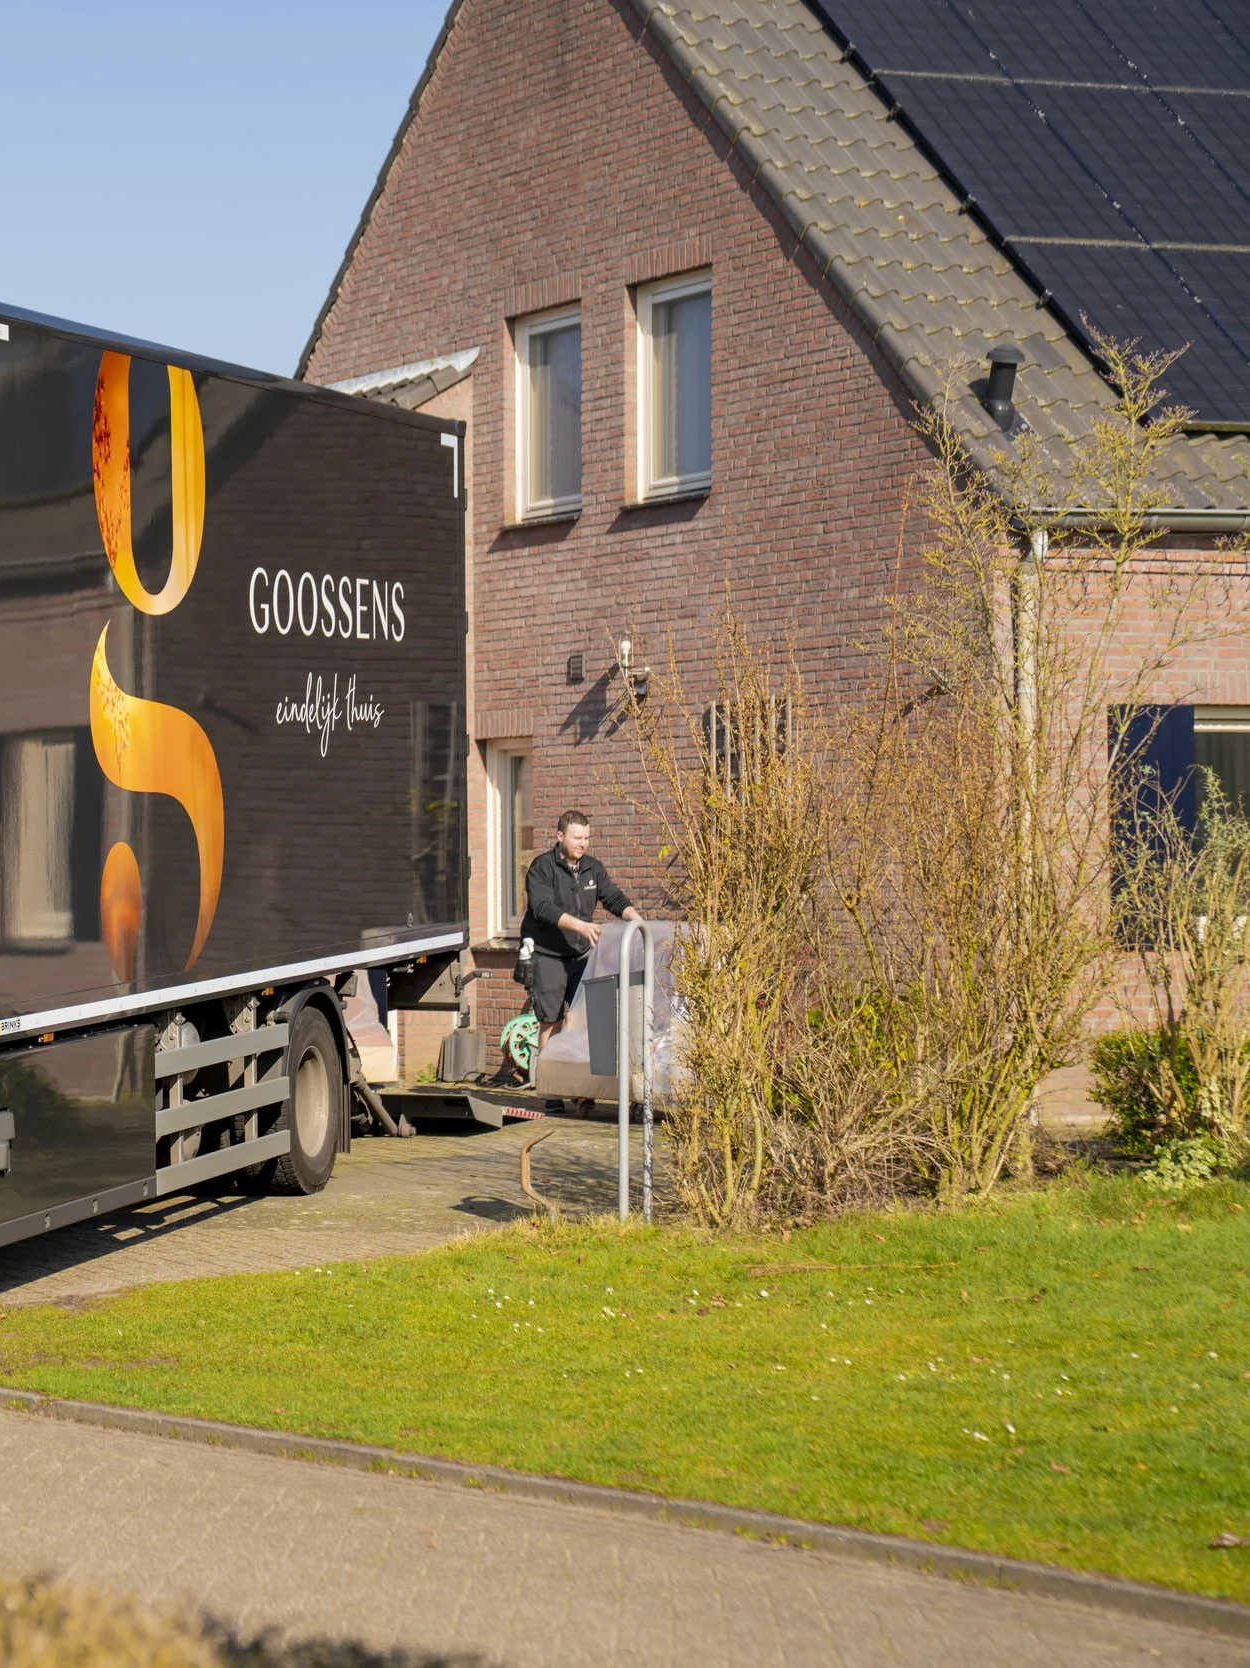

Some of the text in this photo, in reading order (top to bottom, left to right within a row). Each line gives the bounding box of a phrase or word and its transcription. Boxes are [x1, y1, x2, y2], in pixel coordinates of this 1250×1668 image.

[249, 566, 405, 642] GOOSSENS
[276, 671, 385, 757] eindelijk thuis
